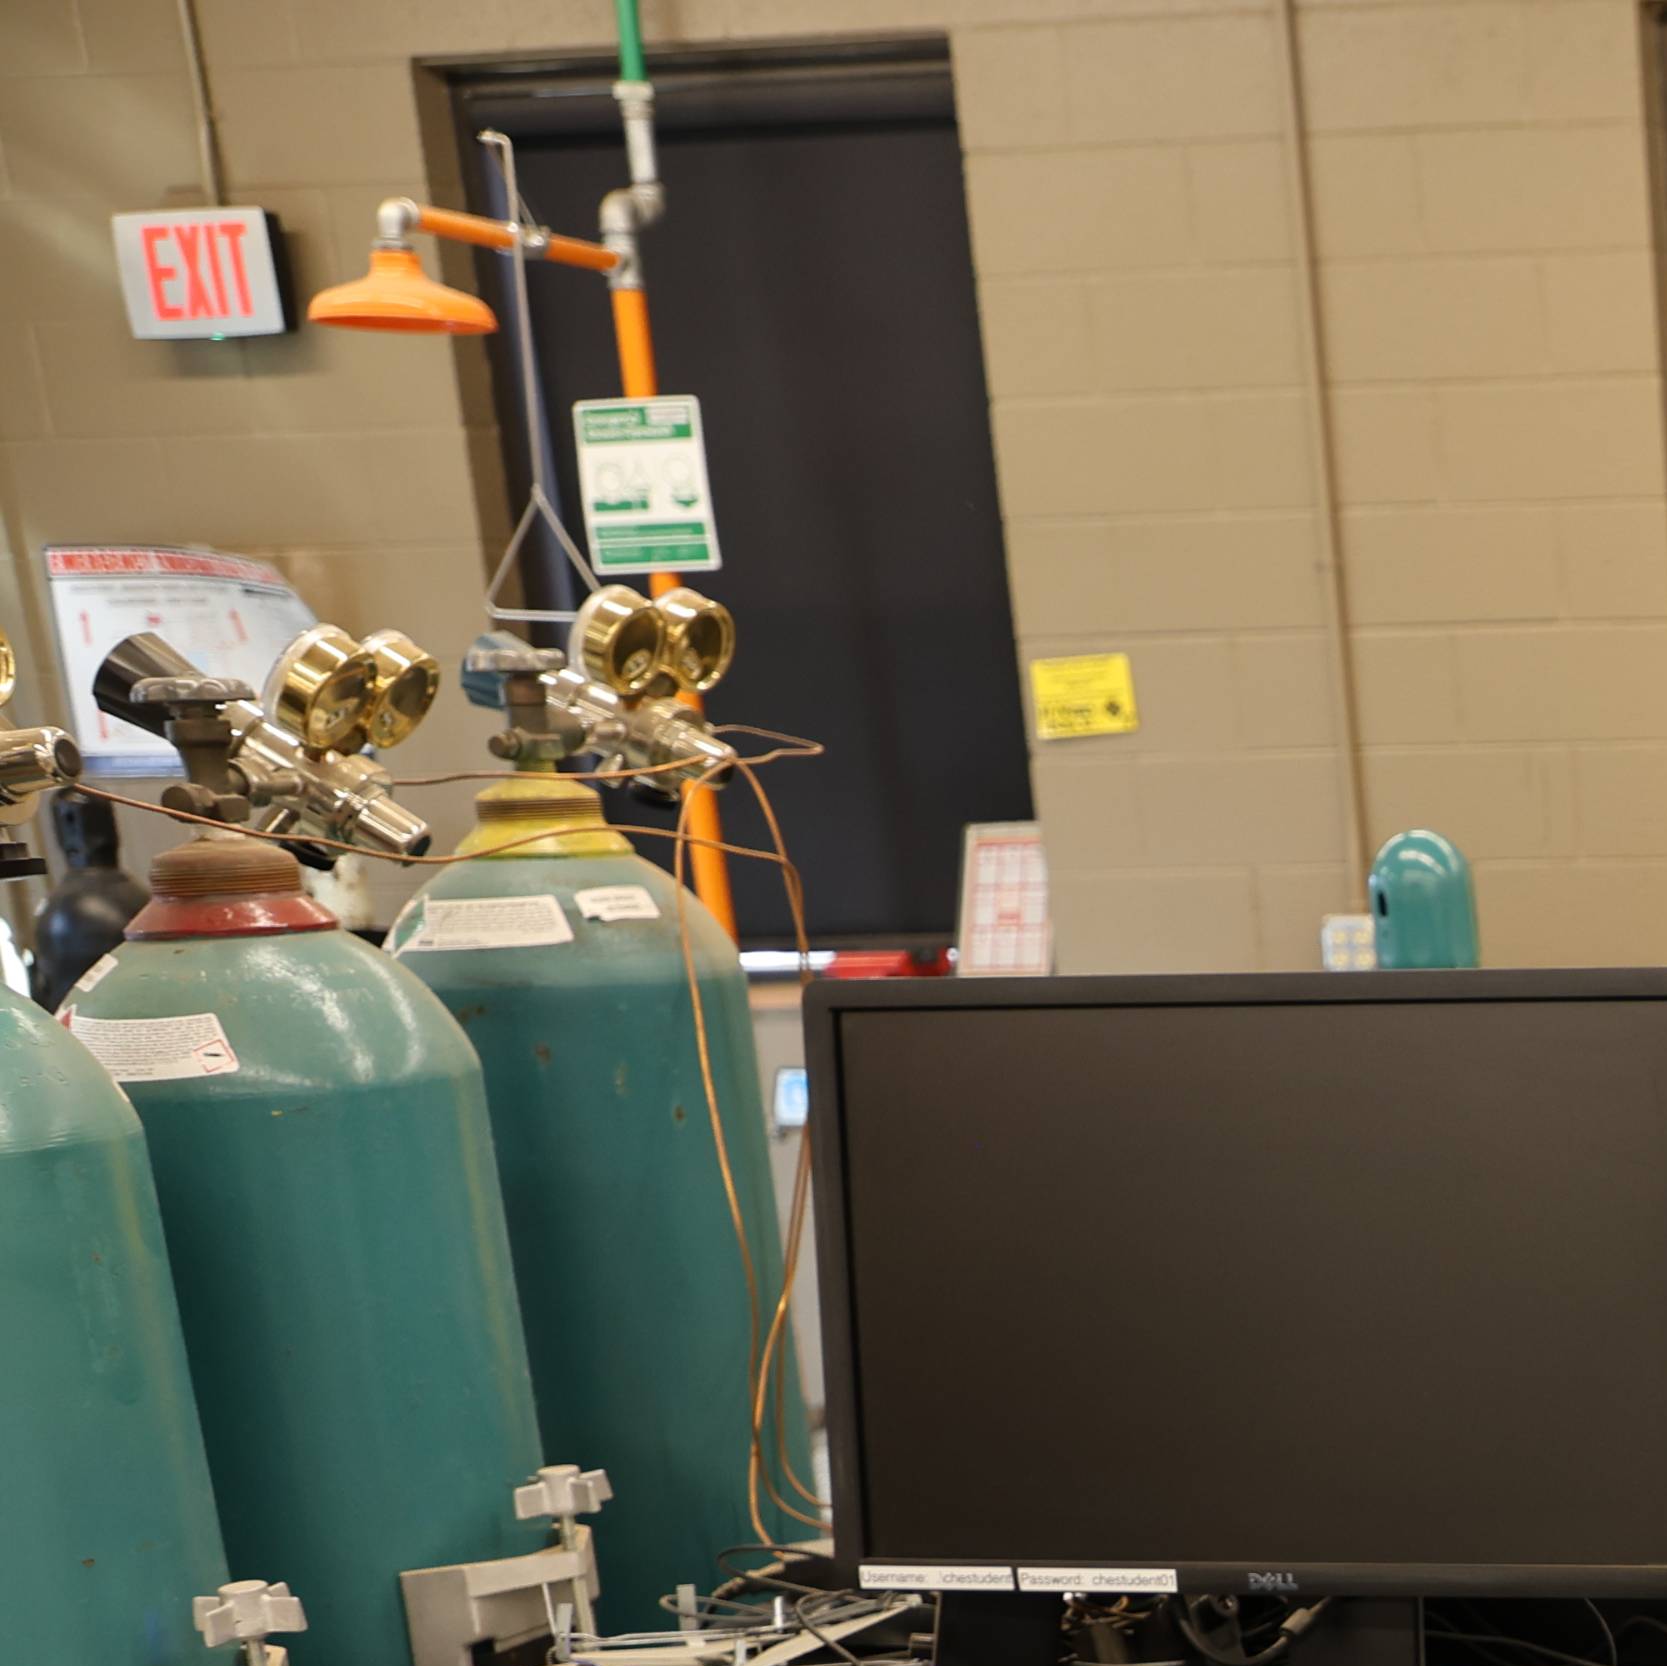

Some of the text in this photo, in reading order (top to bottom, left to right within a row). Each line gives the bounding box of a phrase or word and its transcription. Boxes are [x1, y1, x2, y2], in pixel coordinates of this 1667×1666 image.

[141, 221, 255, 321] EXIT
[861, 1570, 928, 1586] Username:
[1020, 1571, 1176, 1588] Password: chestudent01
[1247, 1571, 1299, 1591] DELL
